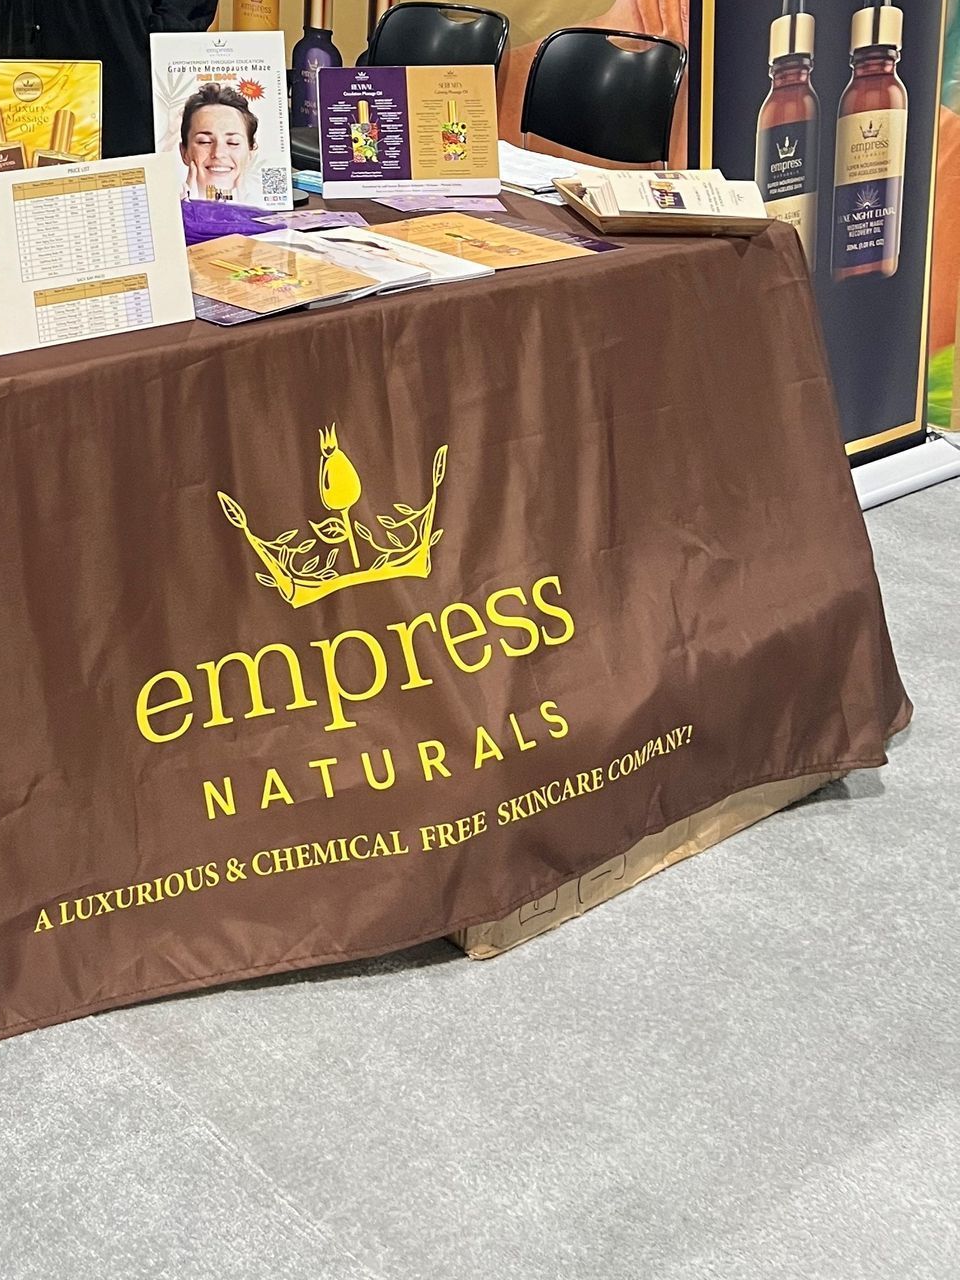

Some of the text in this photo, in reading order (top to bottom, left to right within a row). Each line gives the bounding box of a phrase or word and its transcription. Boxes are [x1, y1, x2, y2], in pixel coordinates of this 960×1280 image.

[204, 64, 249, 73] Menopause
[8, 103, 47, 114] Luxury
[6, 113, 50, 125] Massage
[19, 124, 35, 133] Oil
[850, 138, 889, 154] empress
[770, 157, 803, 173] empress
[852, 209, 874, 221] NIGHT
[848, 228, 873, 238] RECOVERY
[135, 575, 576, 745] empress
[204, 699, 571, 821] NATURALS
[33, 724, 695, 933] A LUXURIOUS & CHEMICAL FREE SKINCARE COMPANY!
